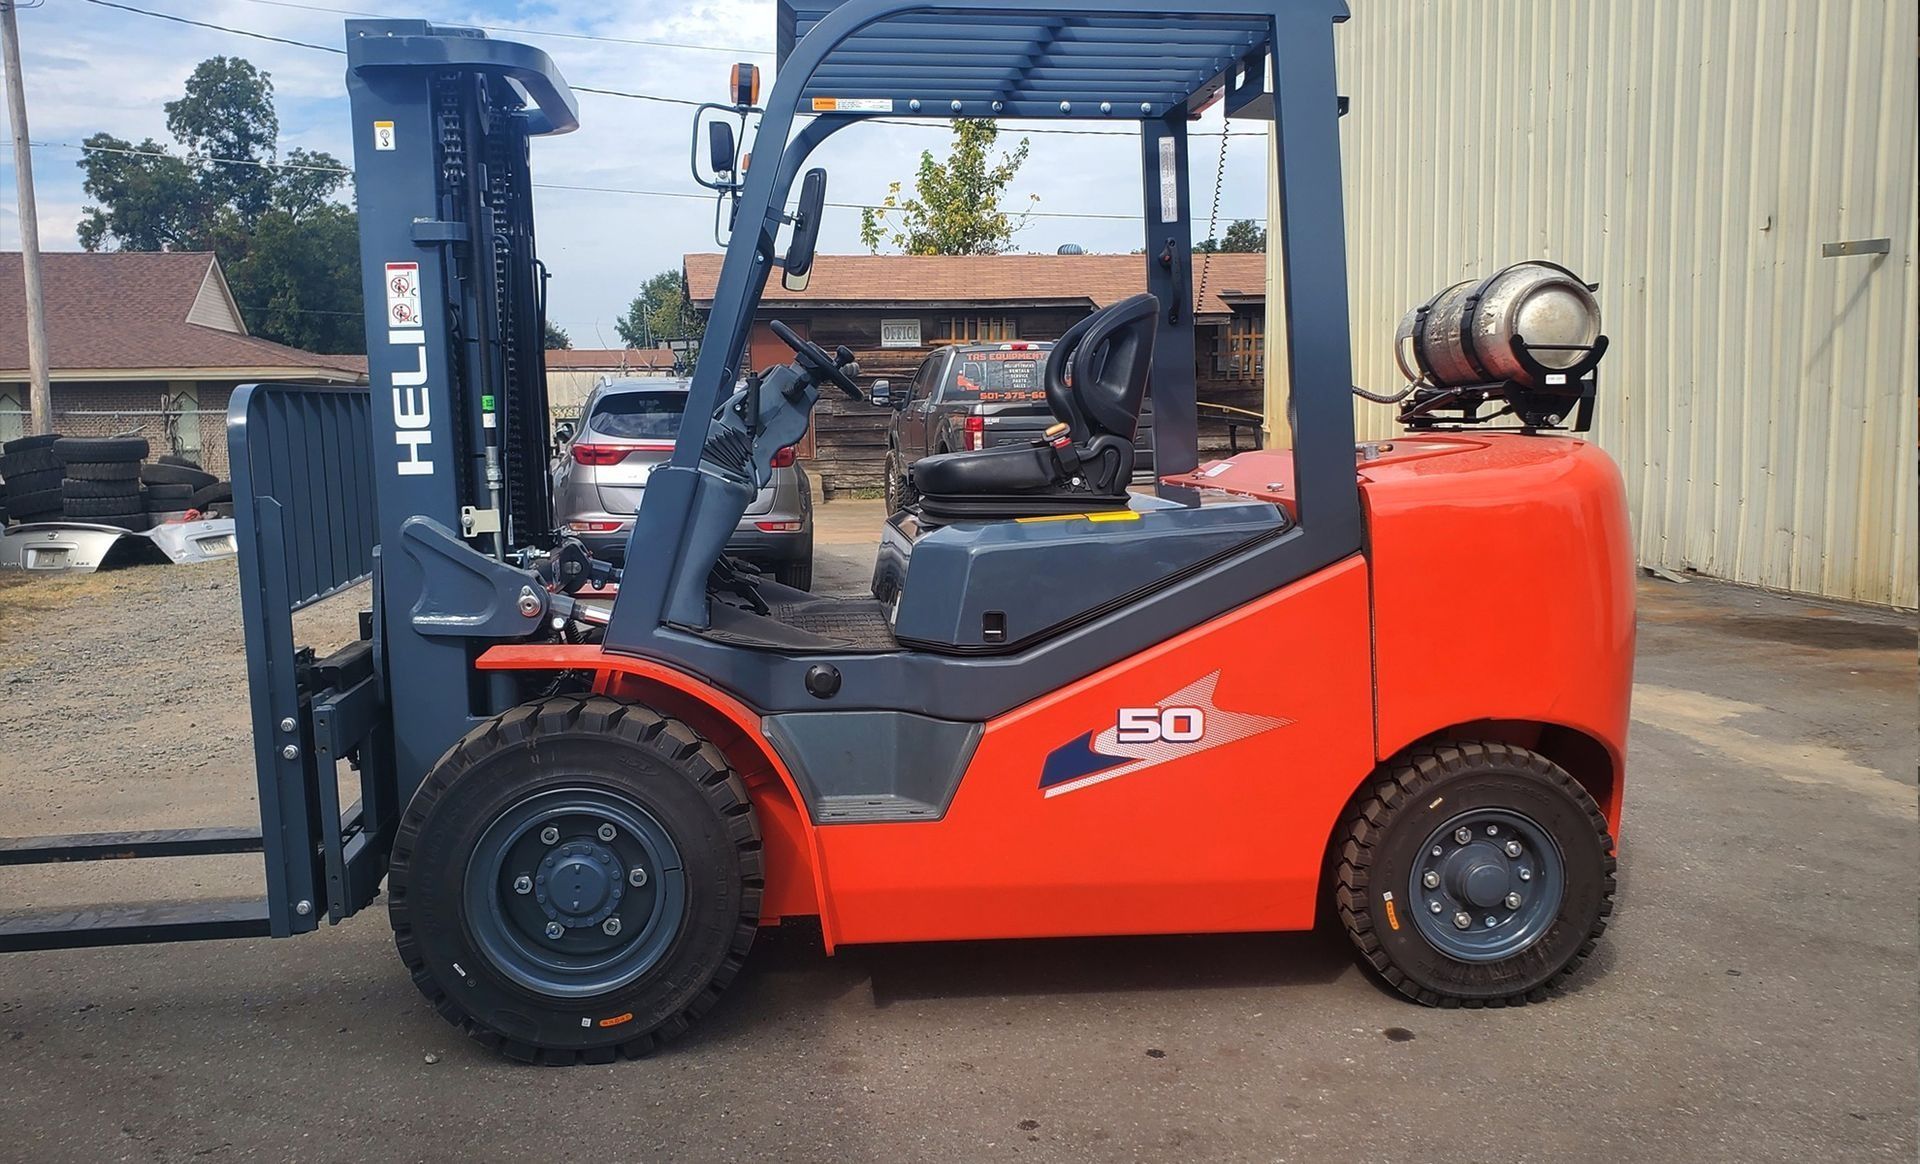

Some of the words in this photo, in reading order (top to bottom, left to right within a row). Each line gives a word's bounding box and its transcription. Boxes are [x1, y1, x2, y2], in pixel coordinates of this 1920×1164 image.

[884, 326, 919, 340] OFFICE
[989, 352, 1045, 360] EQUIPMENT
[389, 330, 434, 475] HELI
[980, 391, 1046, 400] 501-375-60
[1117, 708, 1204, 743] 50
